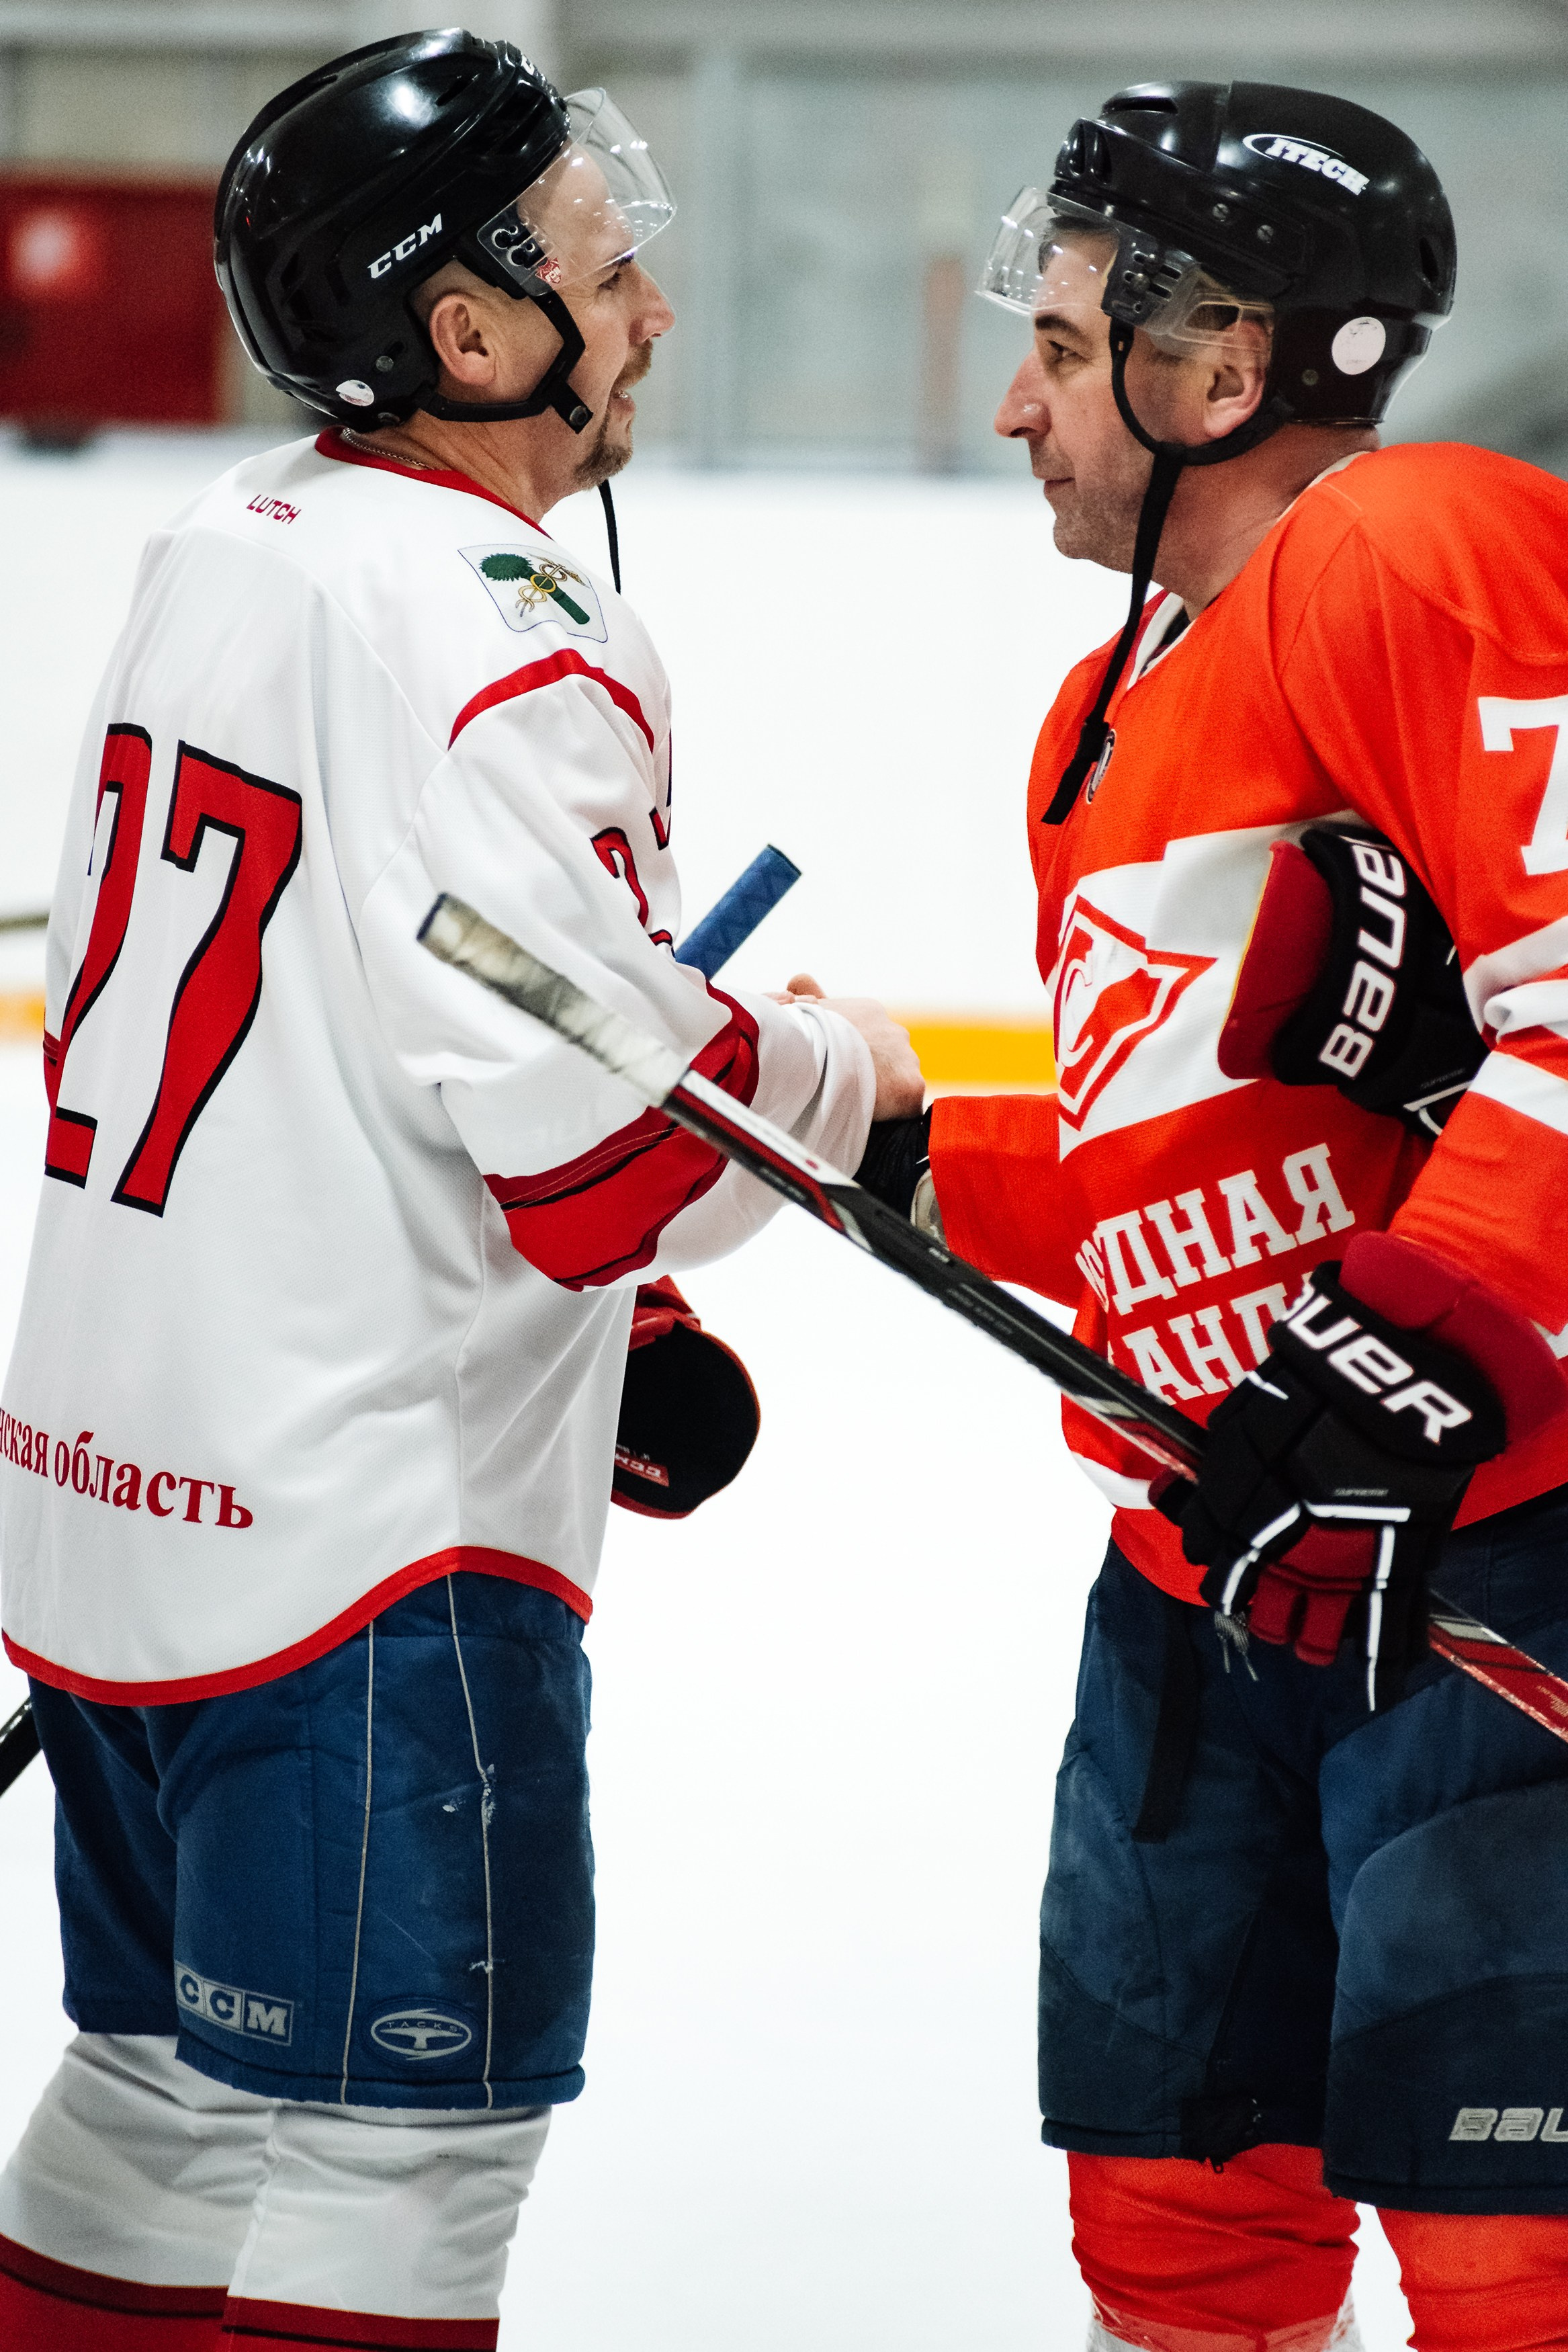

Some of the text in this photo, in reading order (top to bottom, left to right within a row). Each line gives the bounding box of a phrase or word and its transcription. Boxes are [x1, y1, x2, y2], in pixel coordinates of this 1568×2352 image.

[1265, 137, 1370, 196] ITECH
[367, 213, 442, 279] CCM
[247, 494, 302, 525] LUTCH
[44, 722, 302, 1218] 27
[55, 1431, 253, 1529] область
[179, 1974, 288, 2037] CCM
[386, 2021, 458, 2033] TACKS
